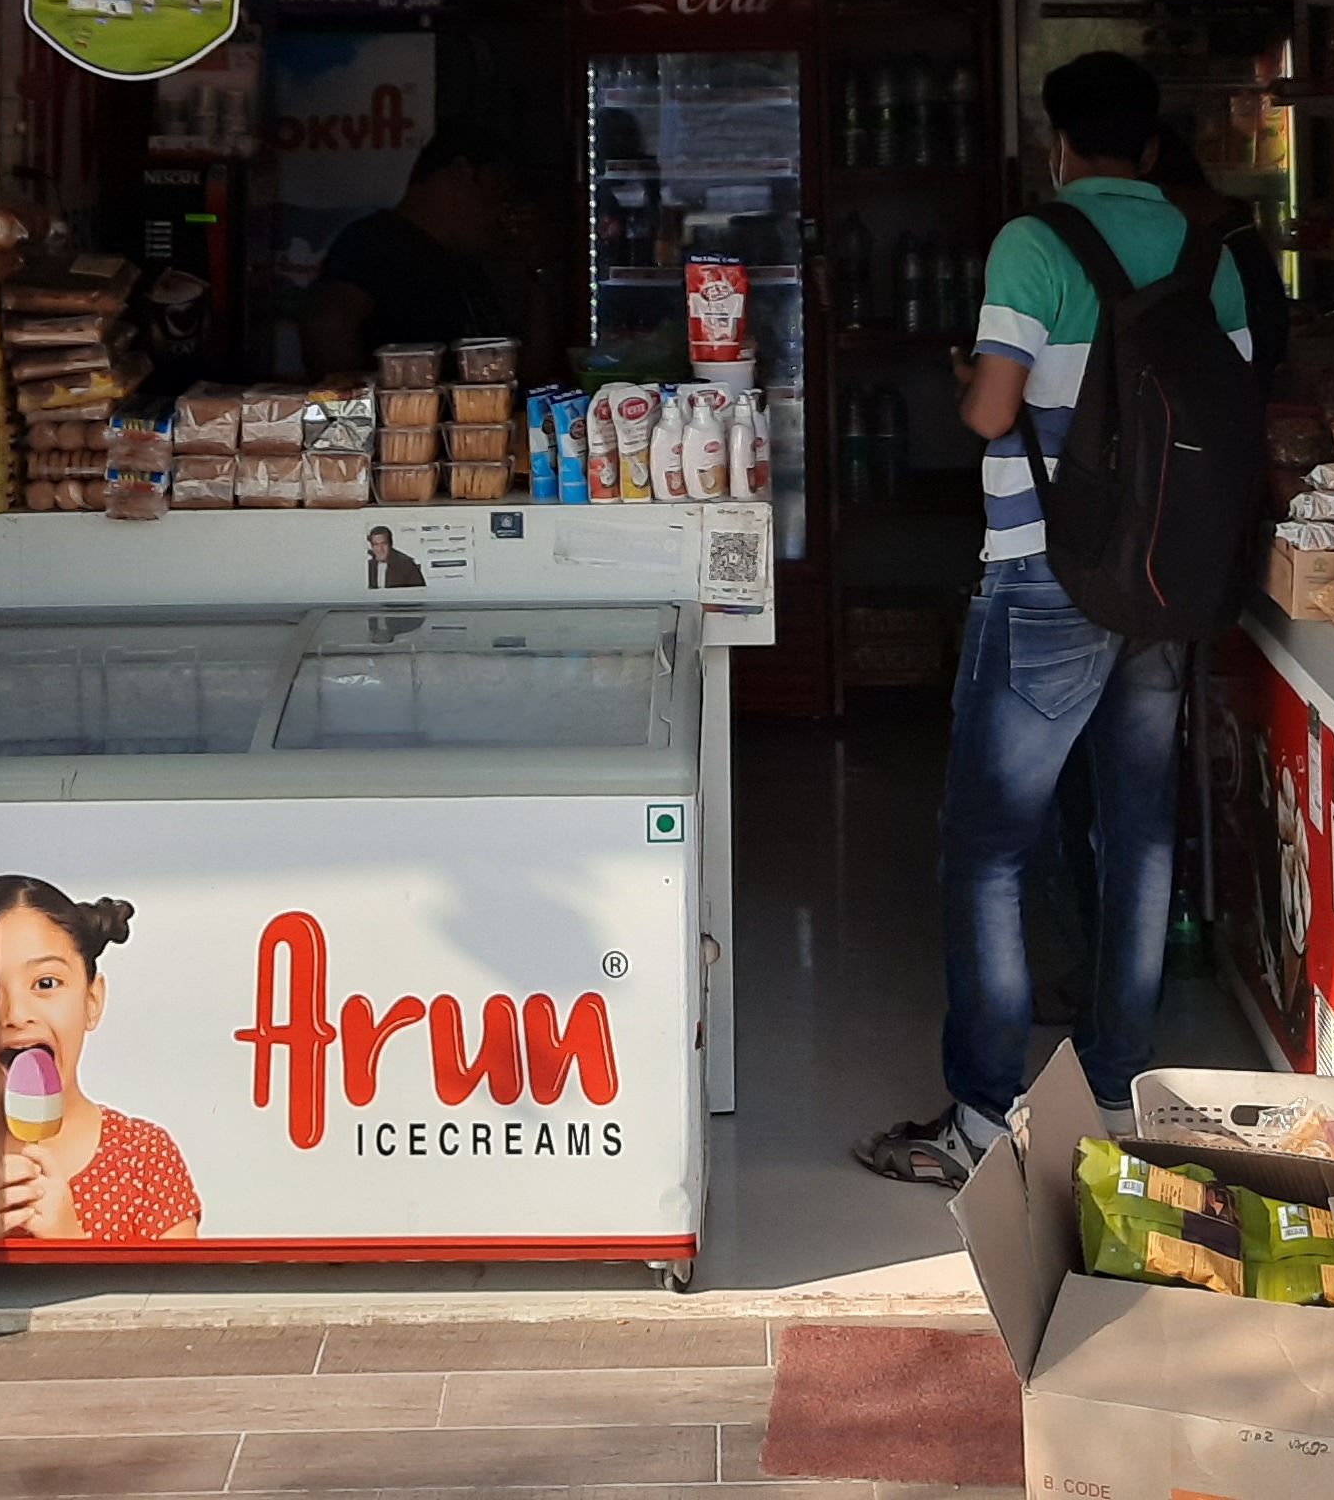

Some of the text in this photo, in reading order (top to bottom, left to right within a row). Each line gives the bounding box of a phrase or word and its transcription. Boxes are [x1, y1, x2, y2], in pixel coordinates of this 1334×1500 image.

[233, 910, 621, 1151] Arun
[356, 1122, 624, 1158] ICECREAMS
[1043, 1475, 1112, 1500] B. CODE
